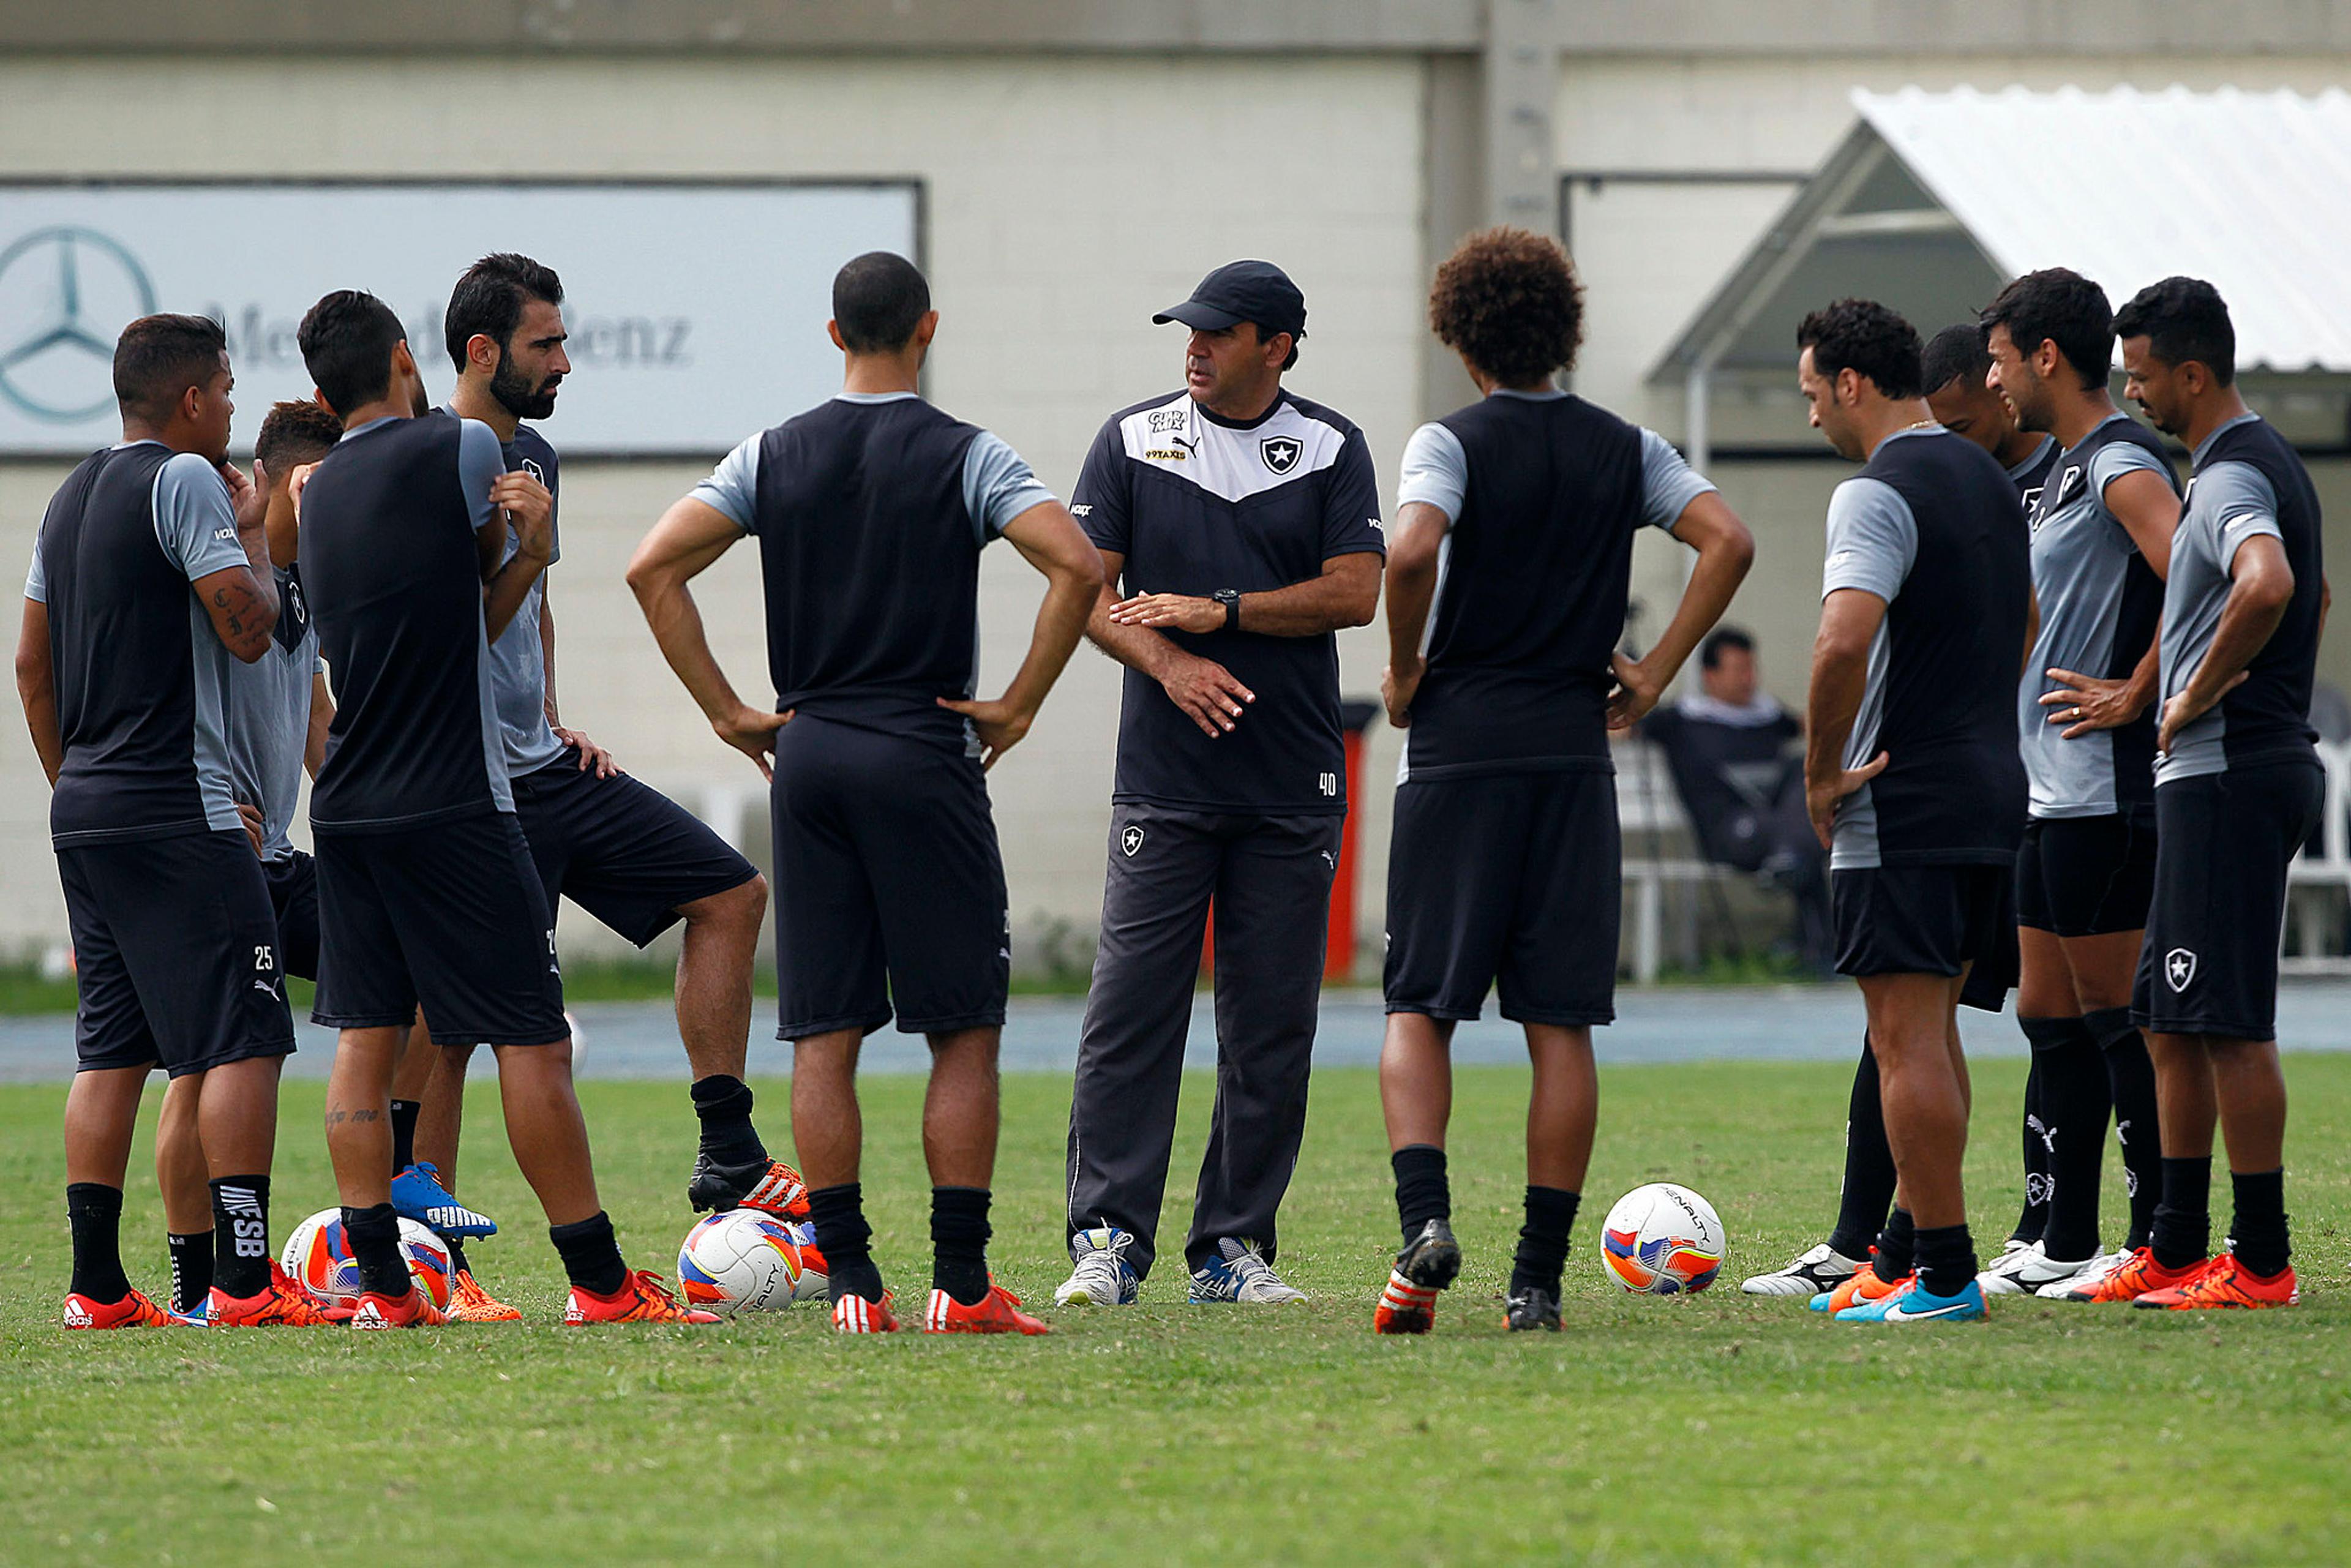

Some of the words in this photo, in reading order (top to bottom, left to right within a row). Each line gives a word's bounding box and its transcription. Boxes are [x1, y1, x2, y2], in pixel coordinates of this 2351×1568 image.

[1152, 419, 1183, 433] MIX
[1319, 772, 1336, 796] 40
[546, 928, 555, 955] 2
[254, 945, 273, 970] 25
[1657, 1186, 1711, 1243] PENALTY
[233, 1218, 265, 1257] SB
